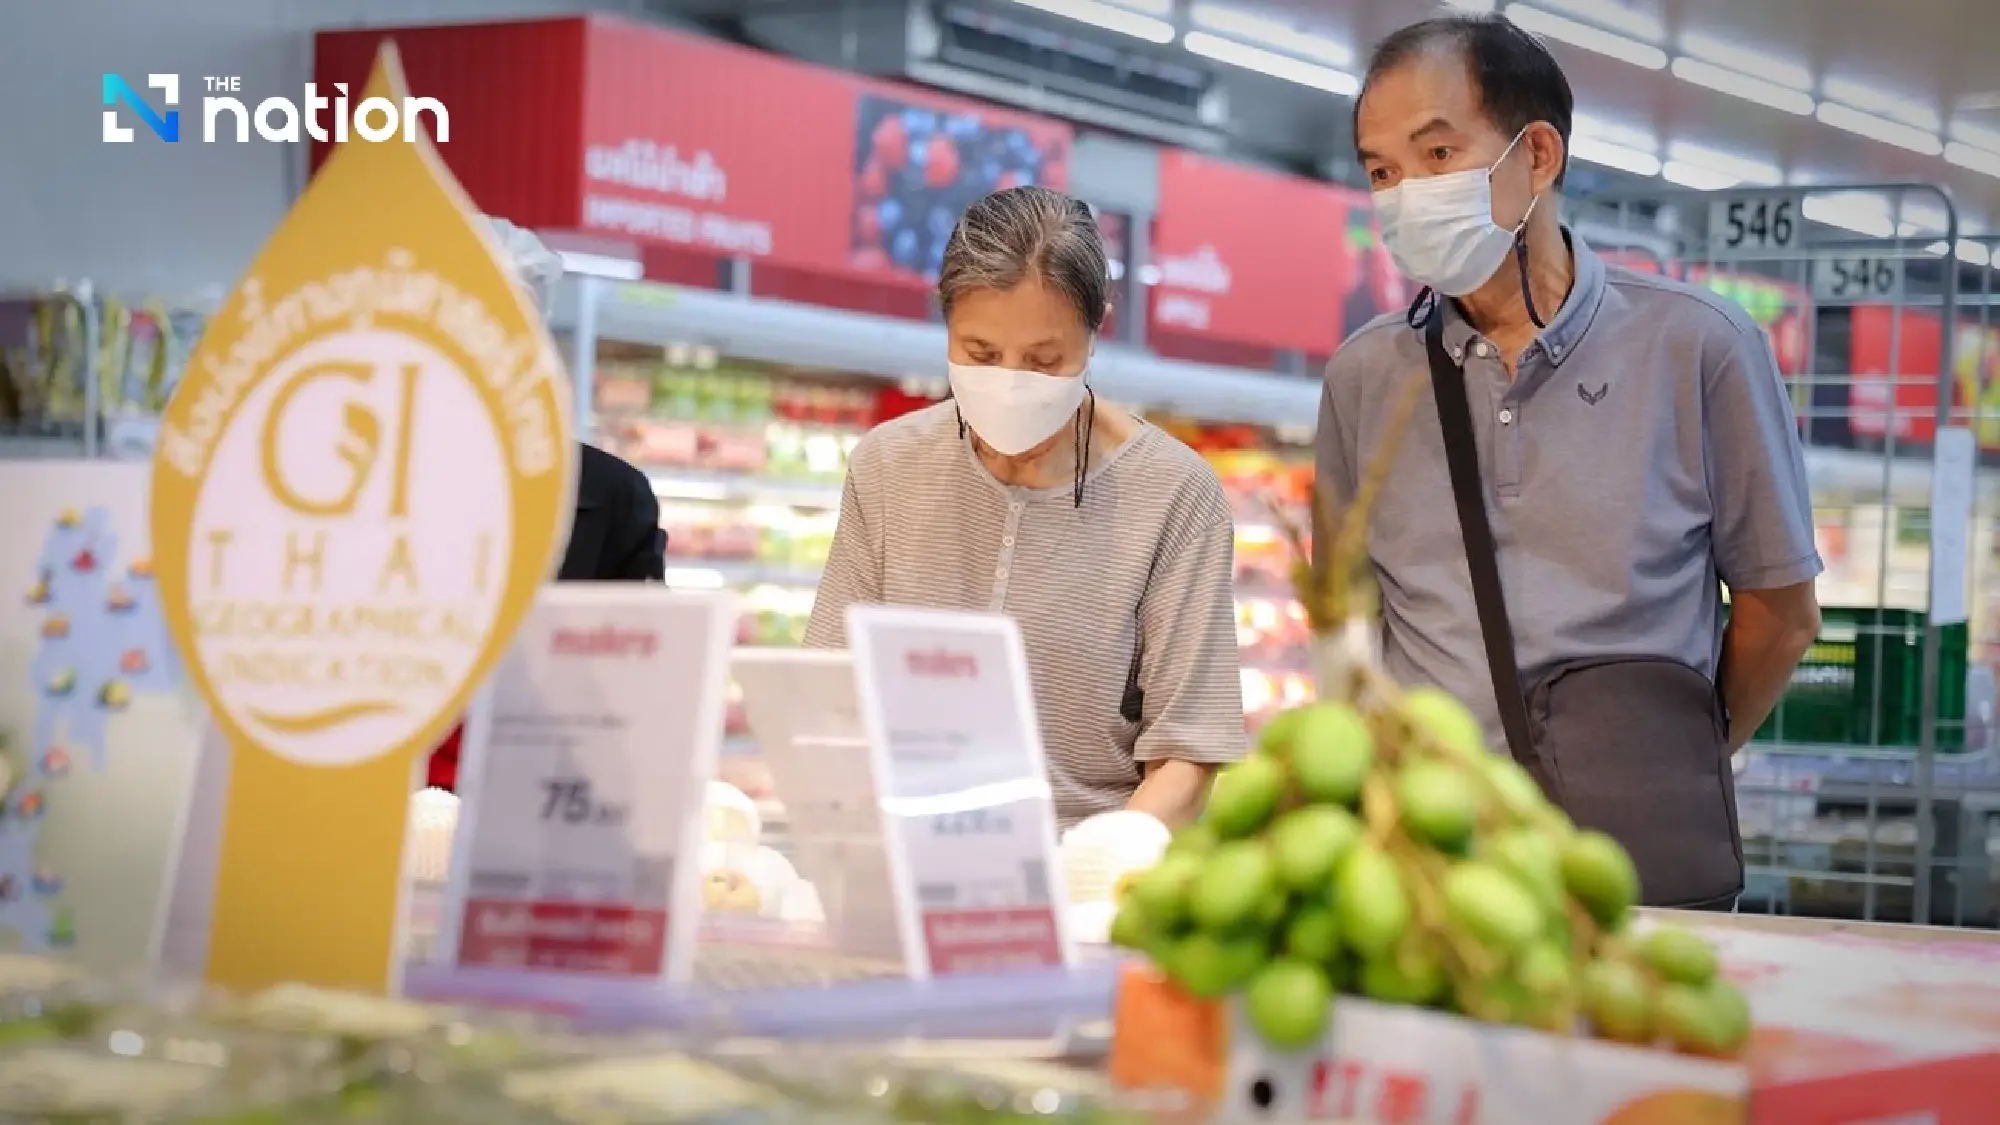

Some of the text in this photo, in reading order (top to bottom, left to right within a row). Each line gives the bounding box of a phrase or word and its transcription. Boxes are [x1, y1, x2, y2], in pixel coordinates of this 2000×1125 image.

[1726, 200, 1791, 247] 546
[1831, 257, 1894, 295] 546
[261, 361, 422, 517] GI
[207, 529, 492, 592] THAI
